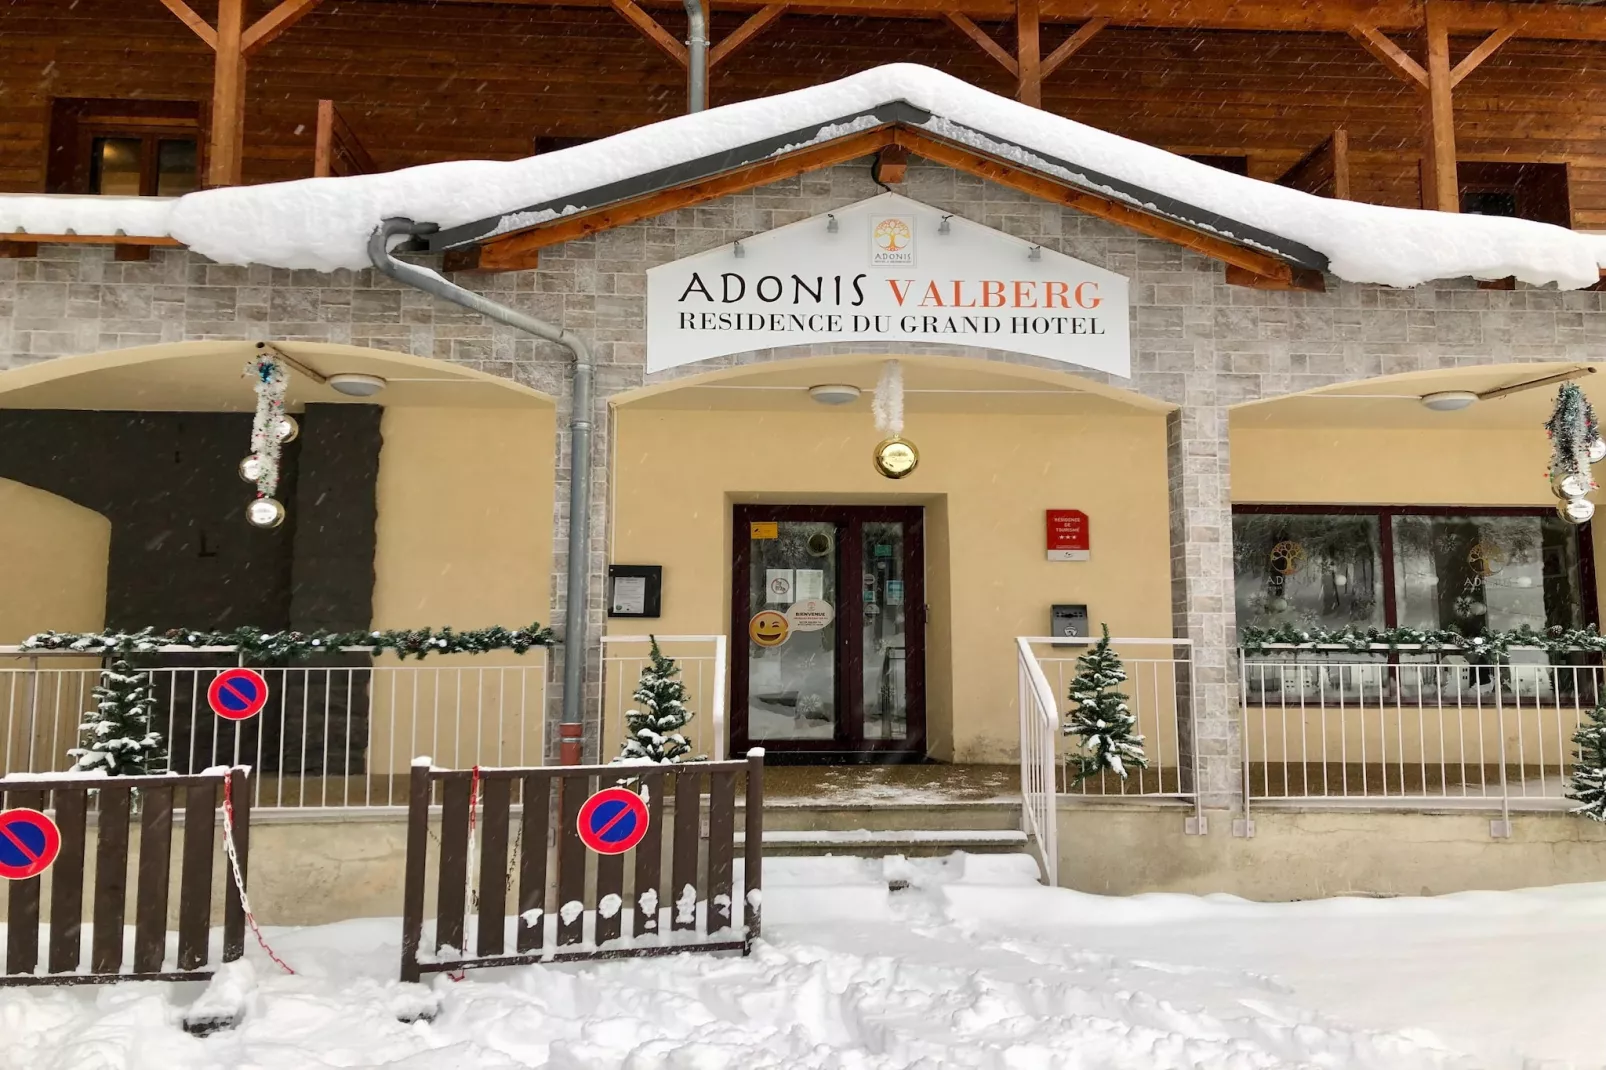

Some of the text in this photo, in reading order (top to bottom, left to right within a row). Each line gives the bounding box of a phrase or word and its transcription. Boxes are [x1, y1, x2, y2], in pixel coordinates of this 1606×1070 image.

[678, 272, 1104, 309] ADONIS VALBERG
[678, 311, 1105, 335] RESIDENCE DU GRAND HOTEL
